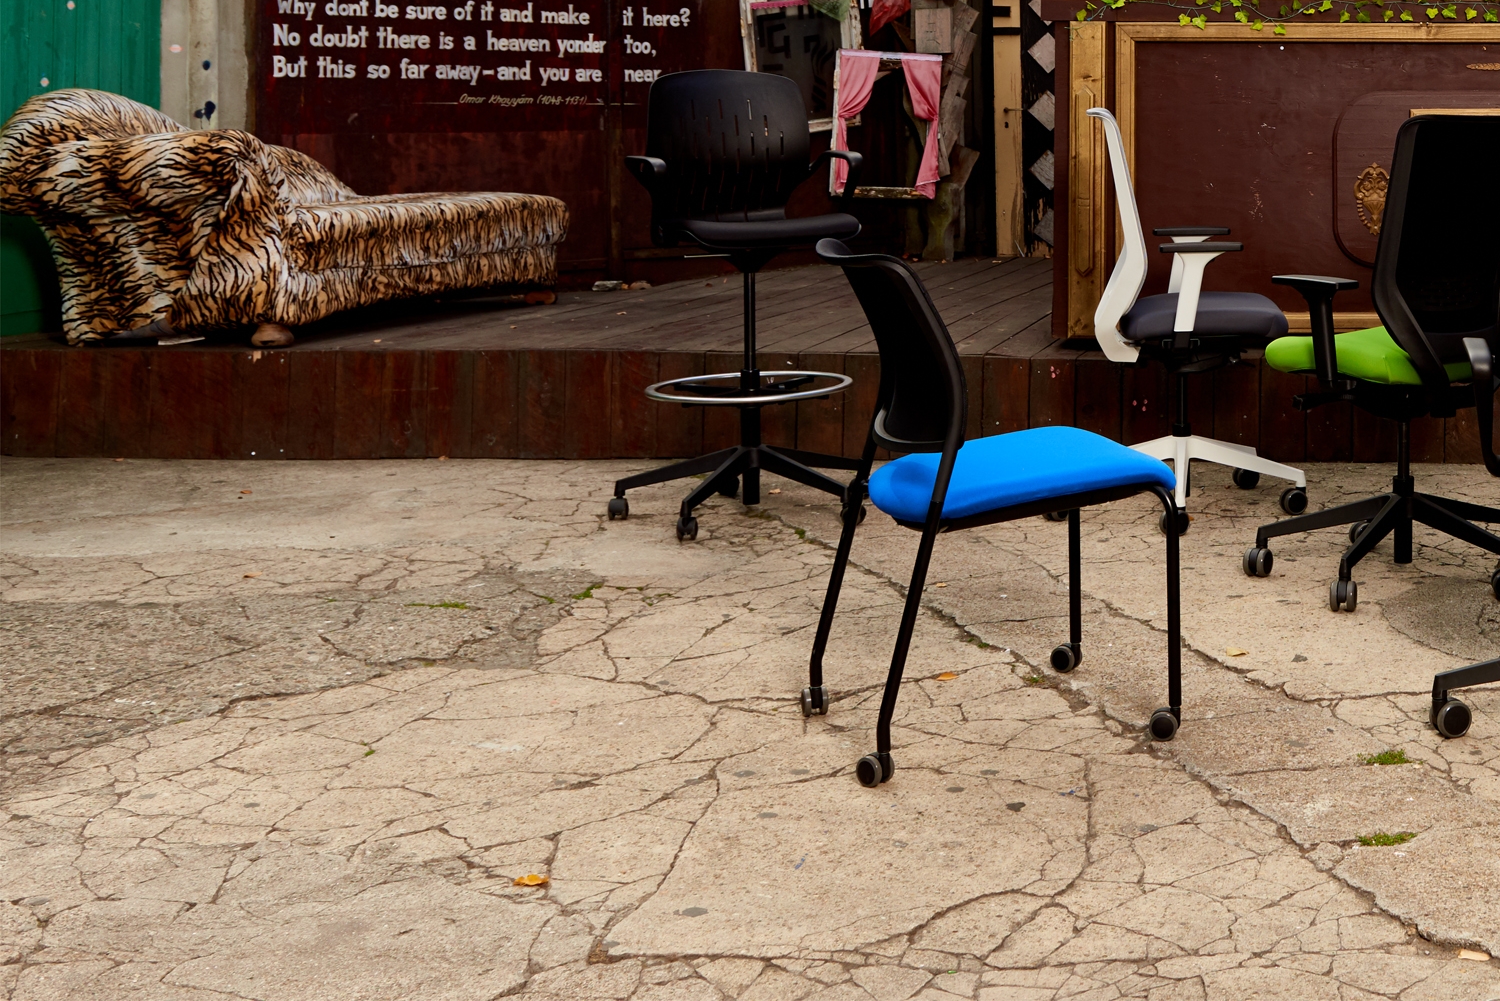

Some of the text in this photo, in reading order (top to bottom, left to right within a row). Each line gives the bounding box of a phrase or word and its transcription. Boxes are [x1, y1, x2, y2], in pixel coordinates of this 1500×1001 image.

[405, 6, 448, 20] sure
[453, 0, 475, 20] of
[480, 1, 495, 21] it
[500, 2, 534, 23] and
[541, 4, 590, 25] make
[622, 6, 634, 26] it
[642, 7, 691, 27] here?
[272, 24, 657, 58] No doubt there is a heaven yonder too,
[272, 55, 308, 77] But
[317, 56, 357, 78] this
[366, 64, 391, 79] so
[400, 58, 430, 79] far
[539, 67, 571, 86] you
[575, 68, 603, 82] are
[624, 69, 662, 83] near
[459, 93, 486, 104] Omar
